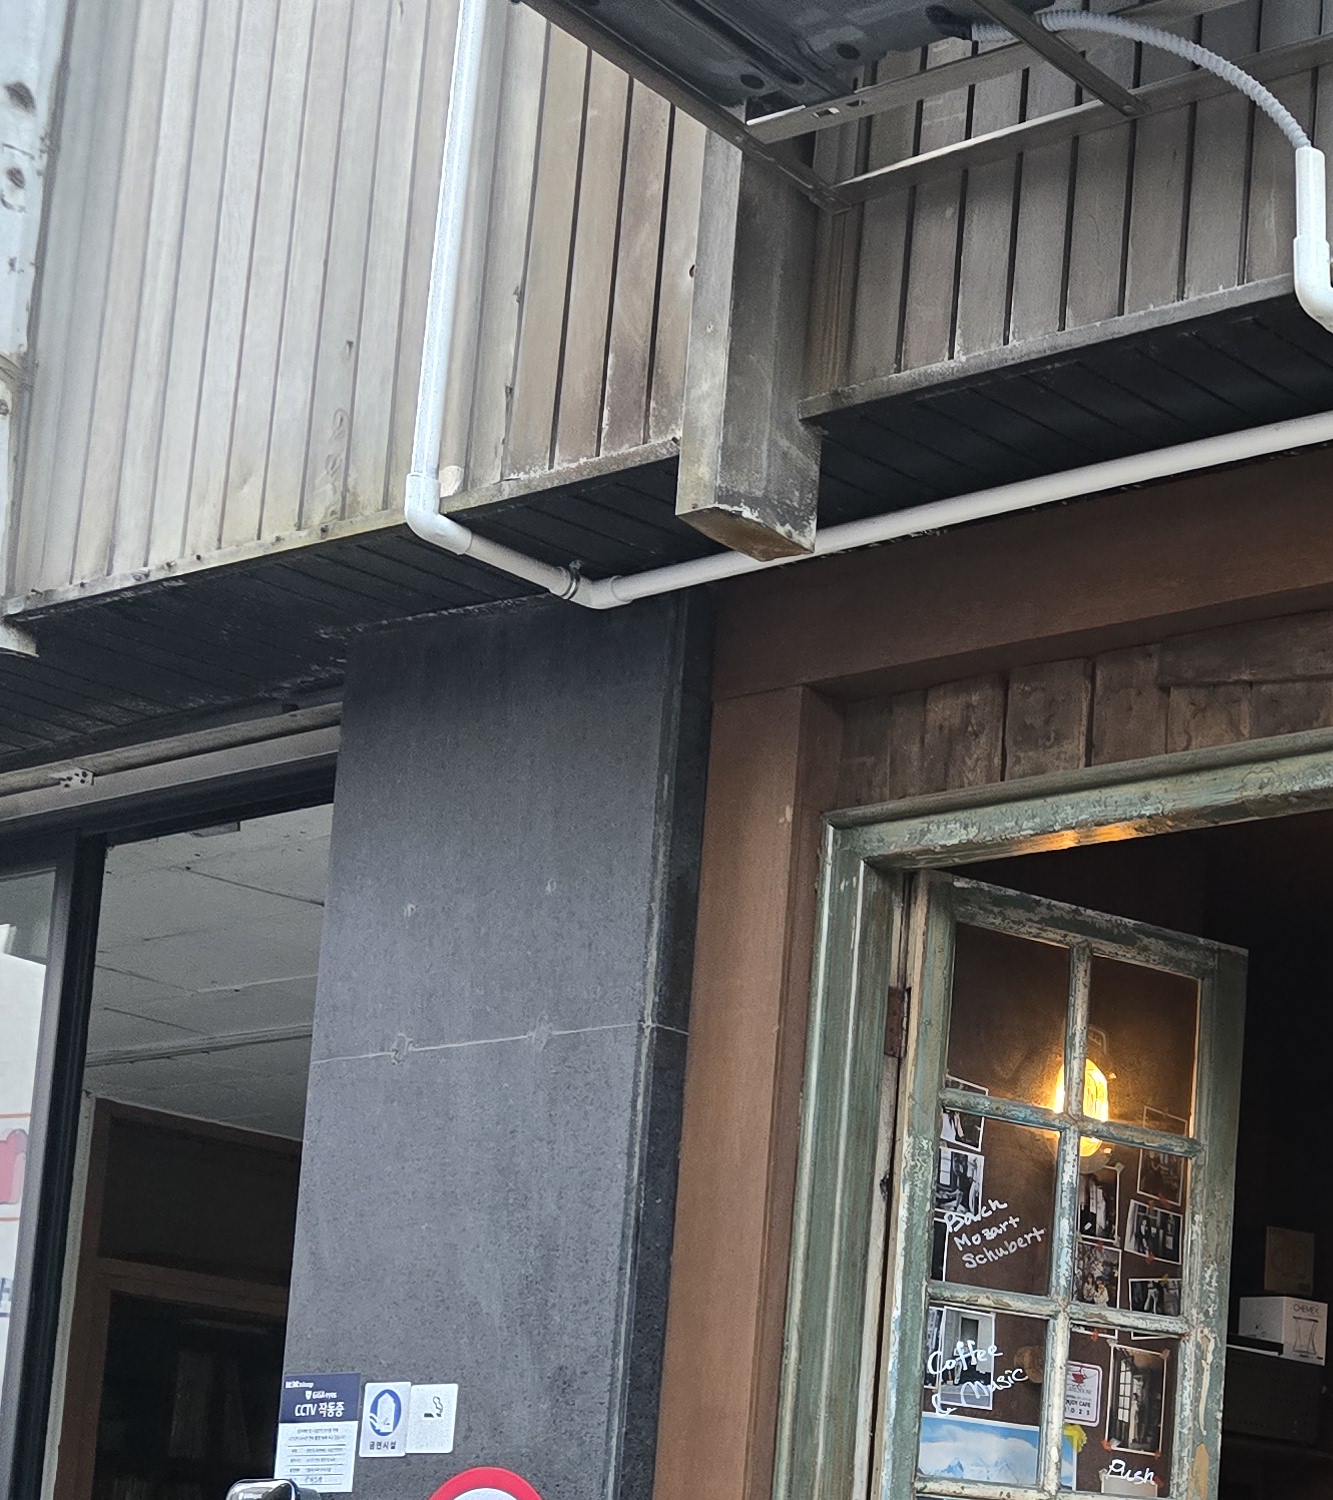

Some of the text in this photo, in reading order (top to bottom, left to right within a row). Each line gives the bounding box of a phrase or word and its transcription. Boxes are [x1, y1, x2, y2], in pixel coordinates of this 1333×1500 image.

[944, 1199, 1008, 1232] Bach
[954, 1216, 1020, 1251] Mozart
[962, 1228, 1047, 1269] Schubert
[927, 1340, 1003, 1375] Coffee
[294, 1403, 317, 1417] CCTV
[1107, 1458, 1156, 1486] Push
